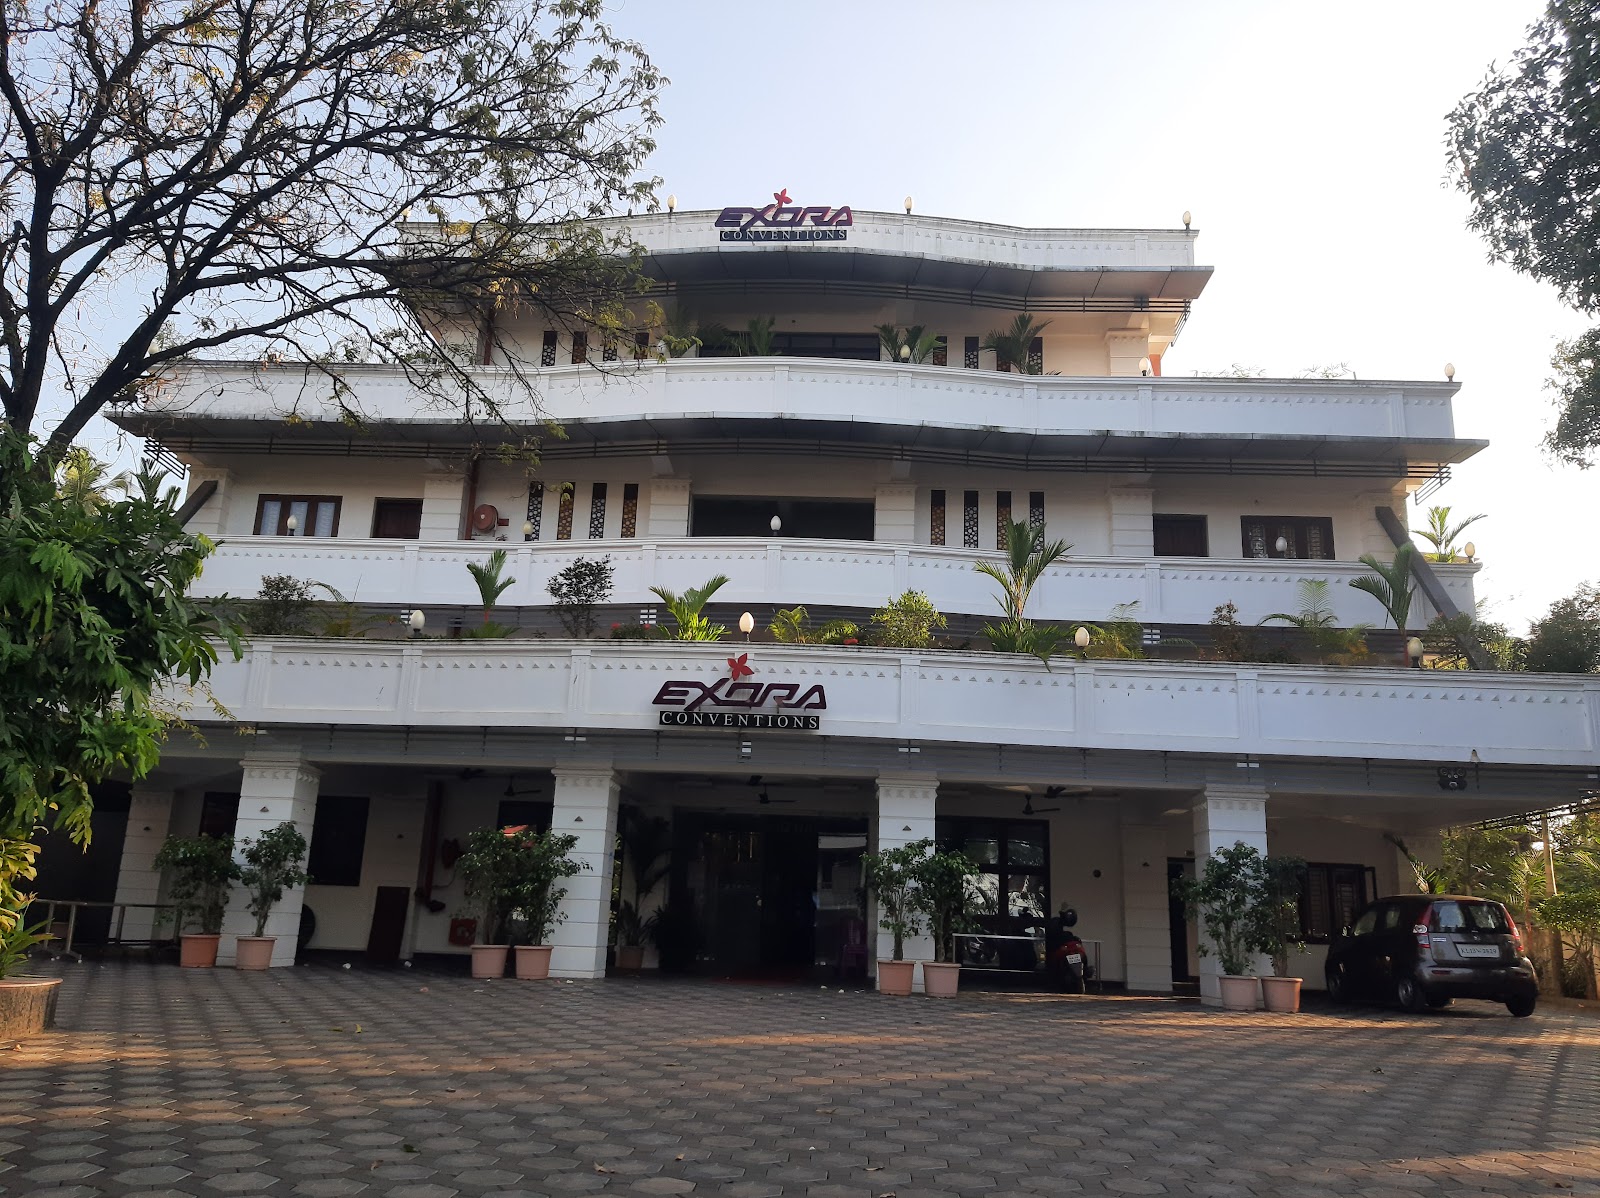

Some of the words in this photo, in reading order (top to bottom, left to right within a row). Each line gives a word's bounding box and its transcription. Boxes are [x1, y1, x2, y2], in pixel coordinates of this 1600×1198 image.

[714, 204, 853, 232] EXORA
[721, 230, 846, 240] CONVENTIONS
[652, 677, 827, 711] EXORA
[661, 712, 818, 729] CONVENTIONS
